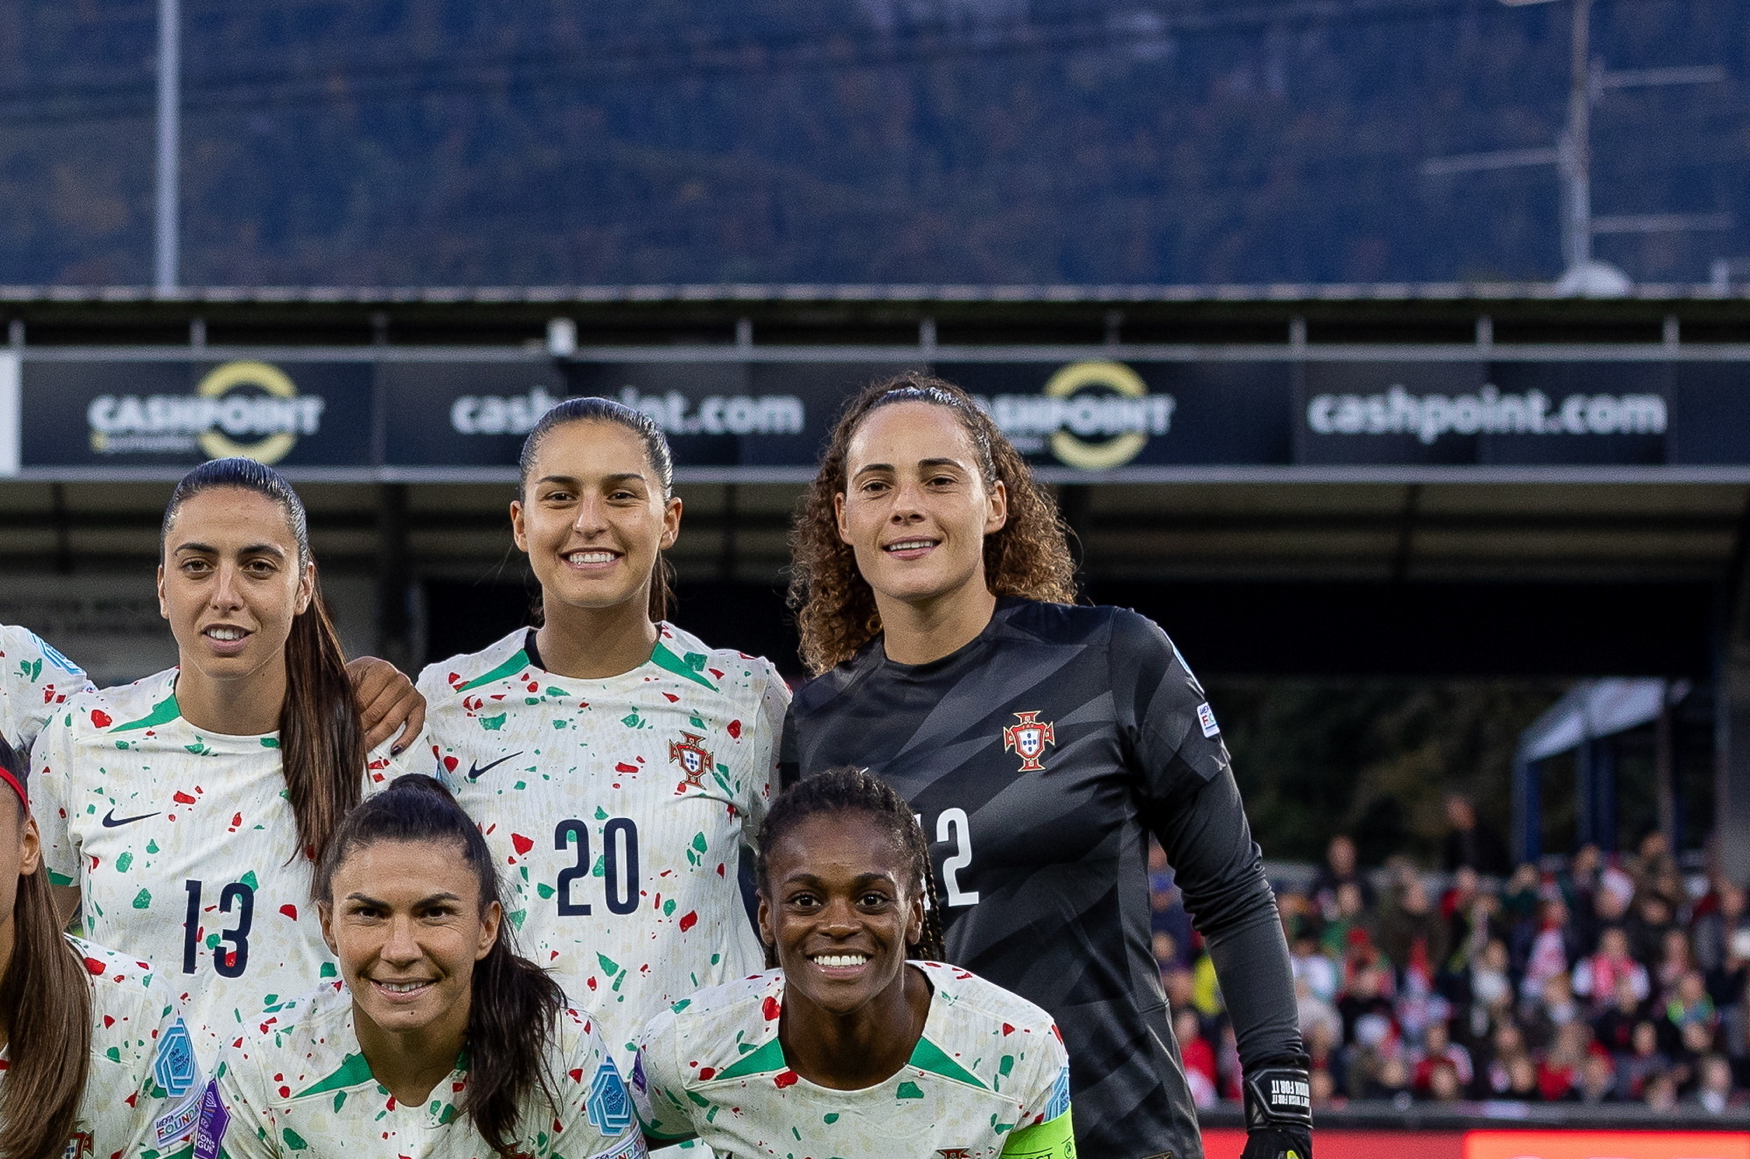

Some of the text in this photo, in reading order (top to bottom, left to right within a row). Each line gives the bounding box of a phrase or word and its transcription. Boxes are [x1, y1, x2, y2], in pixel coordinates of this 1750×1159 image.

[1308, 385, 1667, 444] cashpoint.com
[554, 817, 639, 917] 20
[183, 879, 254, 978] 13
[155, 1114, 174, 1129] UEFA
